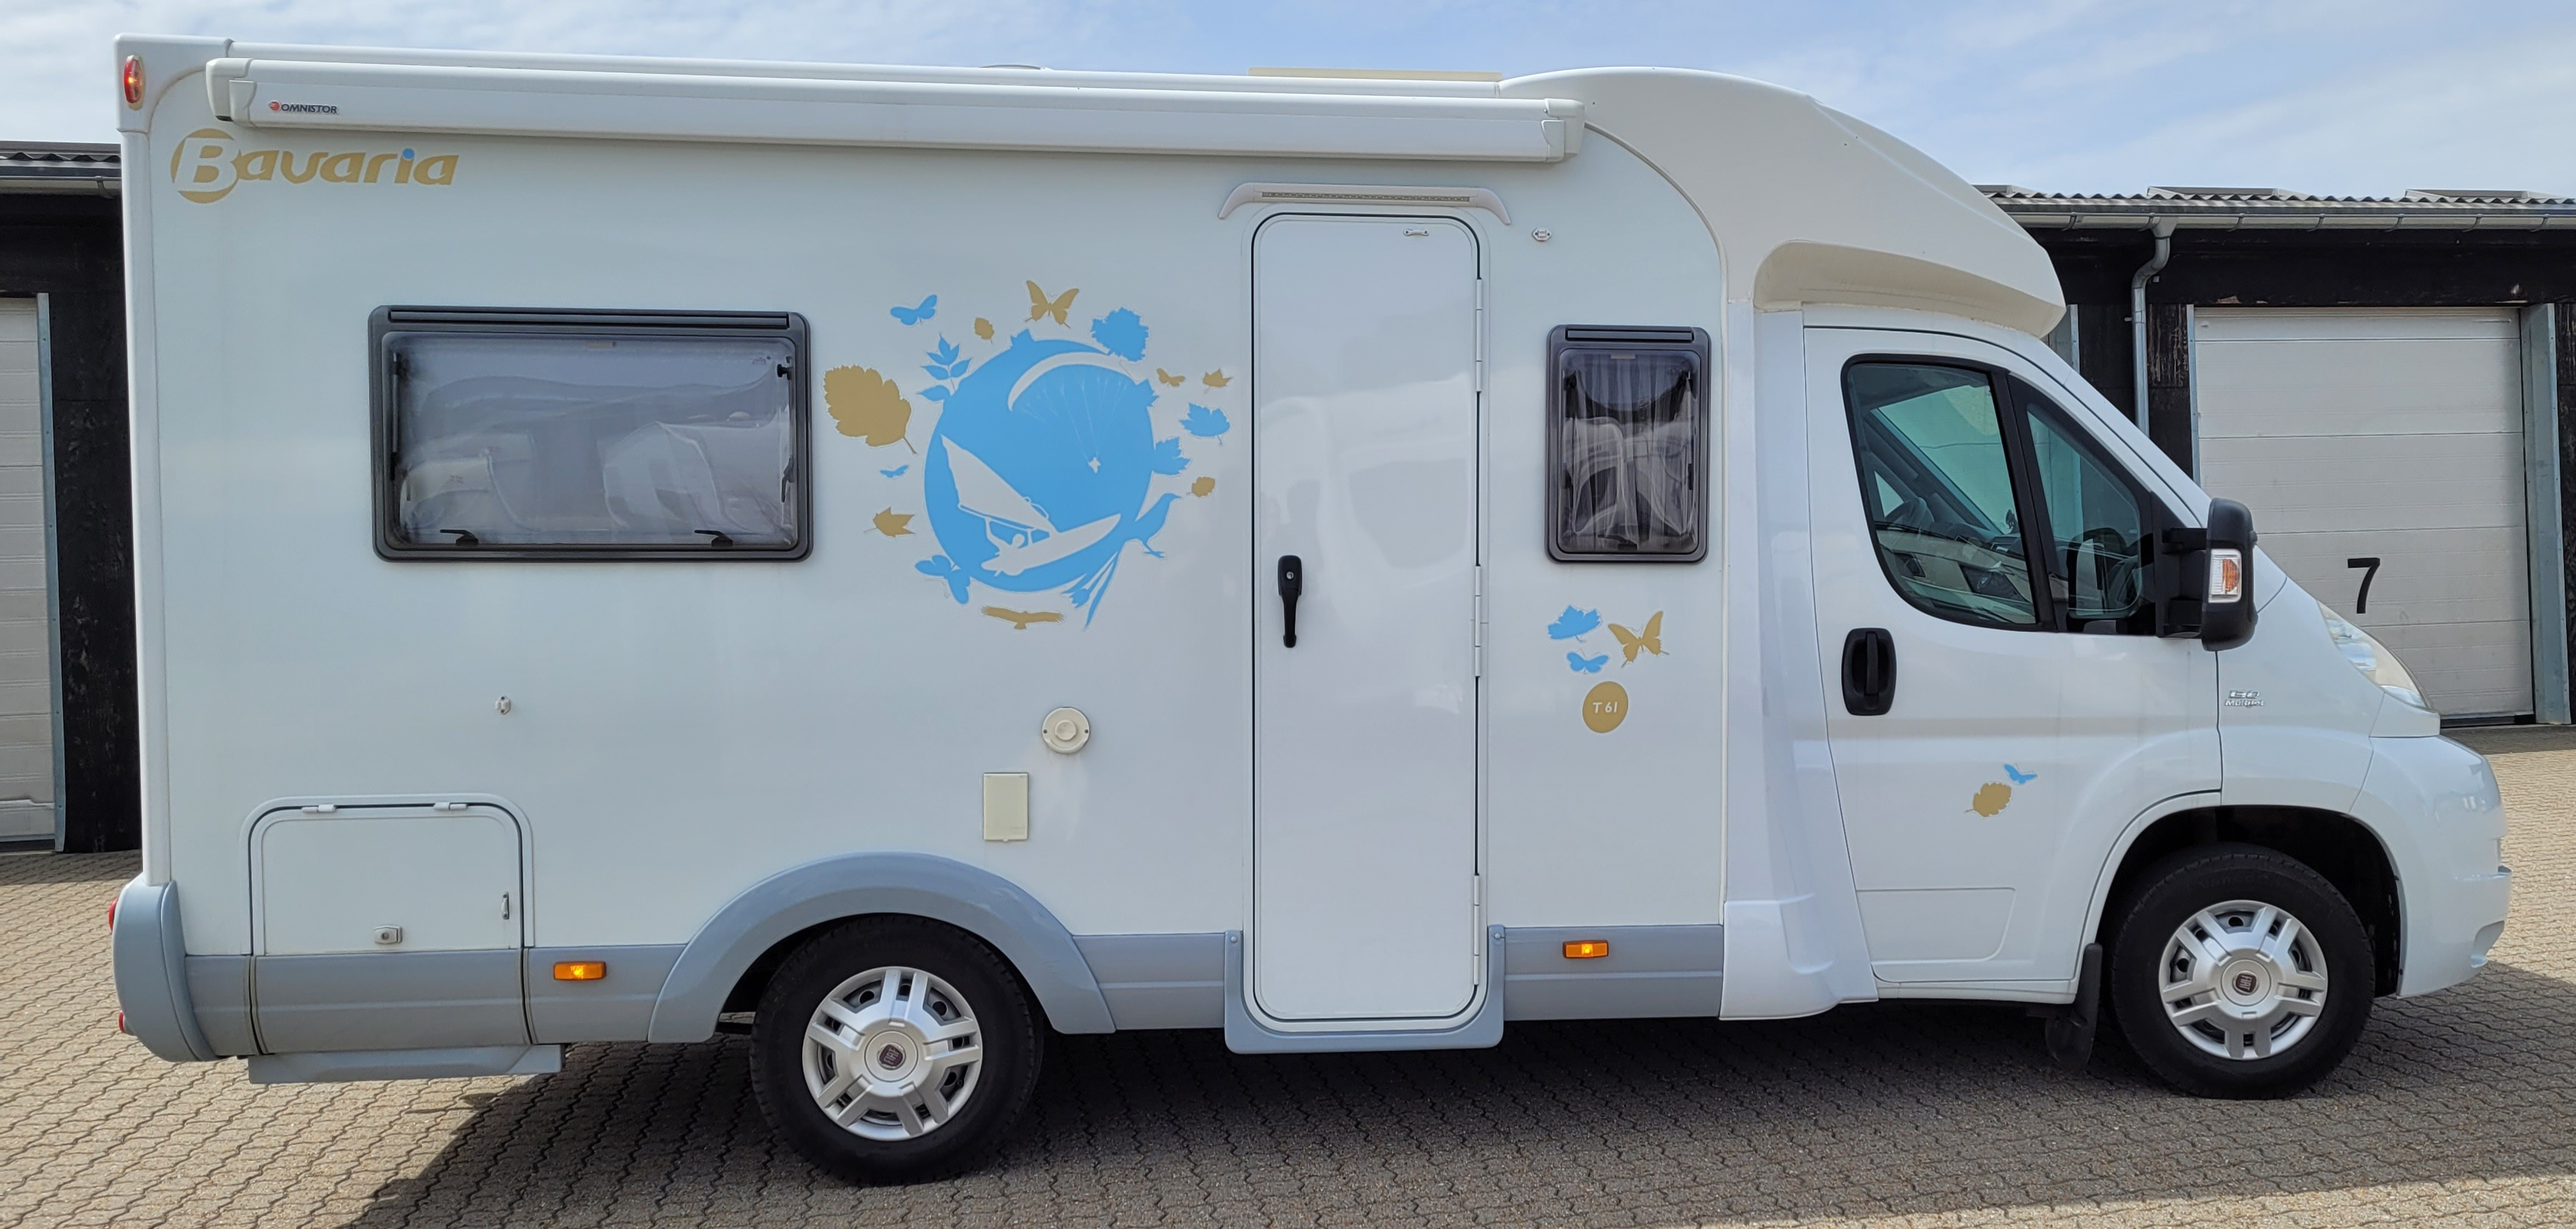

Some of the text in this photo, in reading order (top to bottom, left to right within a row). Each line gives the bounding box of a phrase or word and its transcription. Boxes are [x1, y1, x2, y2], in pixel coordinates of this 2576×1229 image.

[281, 103, 338, 114] OMNISTOR
[171, 131, 459, 199] Bavaria
[2347, 557, 2380, 614] 7
[2239, 975, 2252, 991] FIAT
[883, 1047, 900, 1065] FIAT
